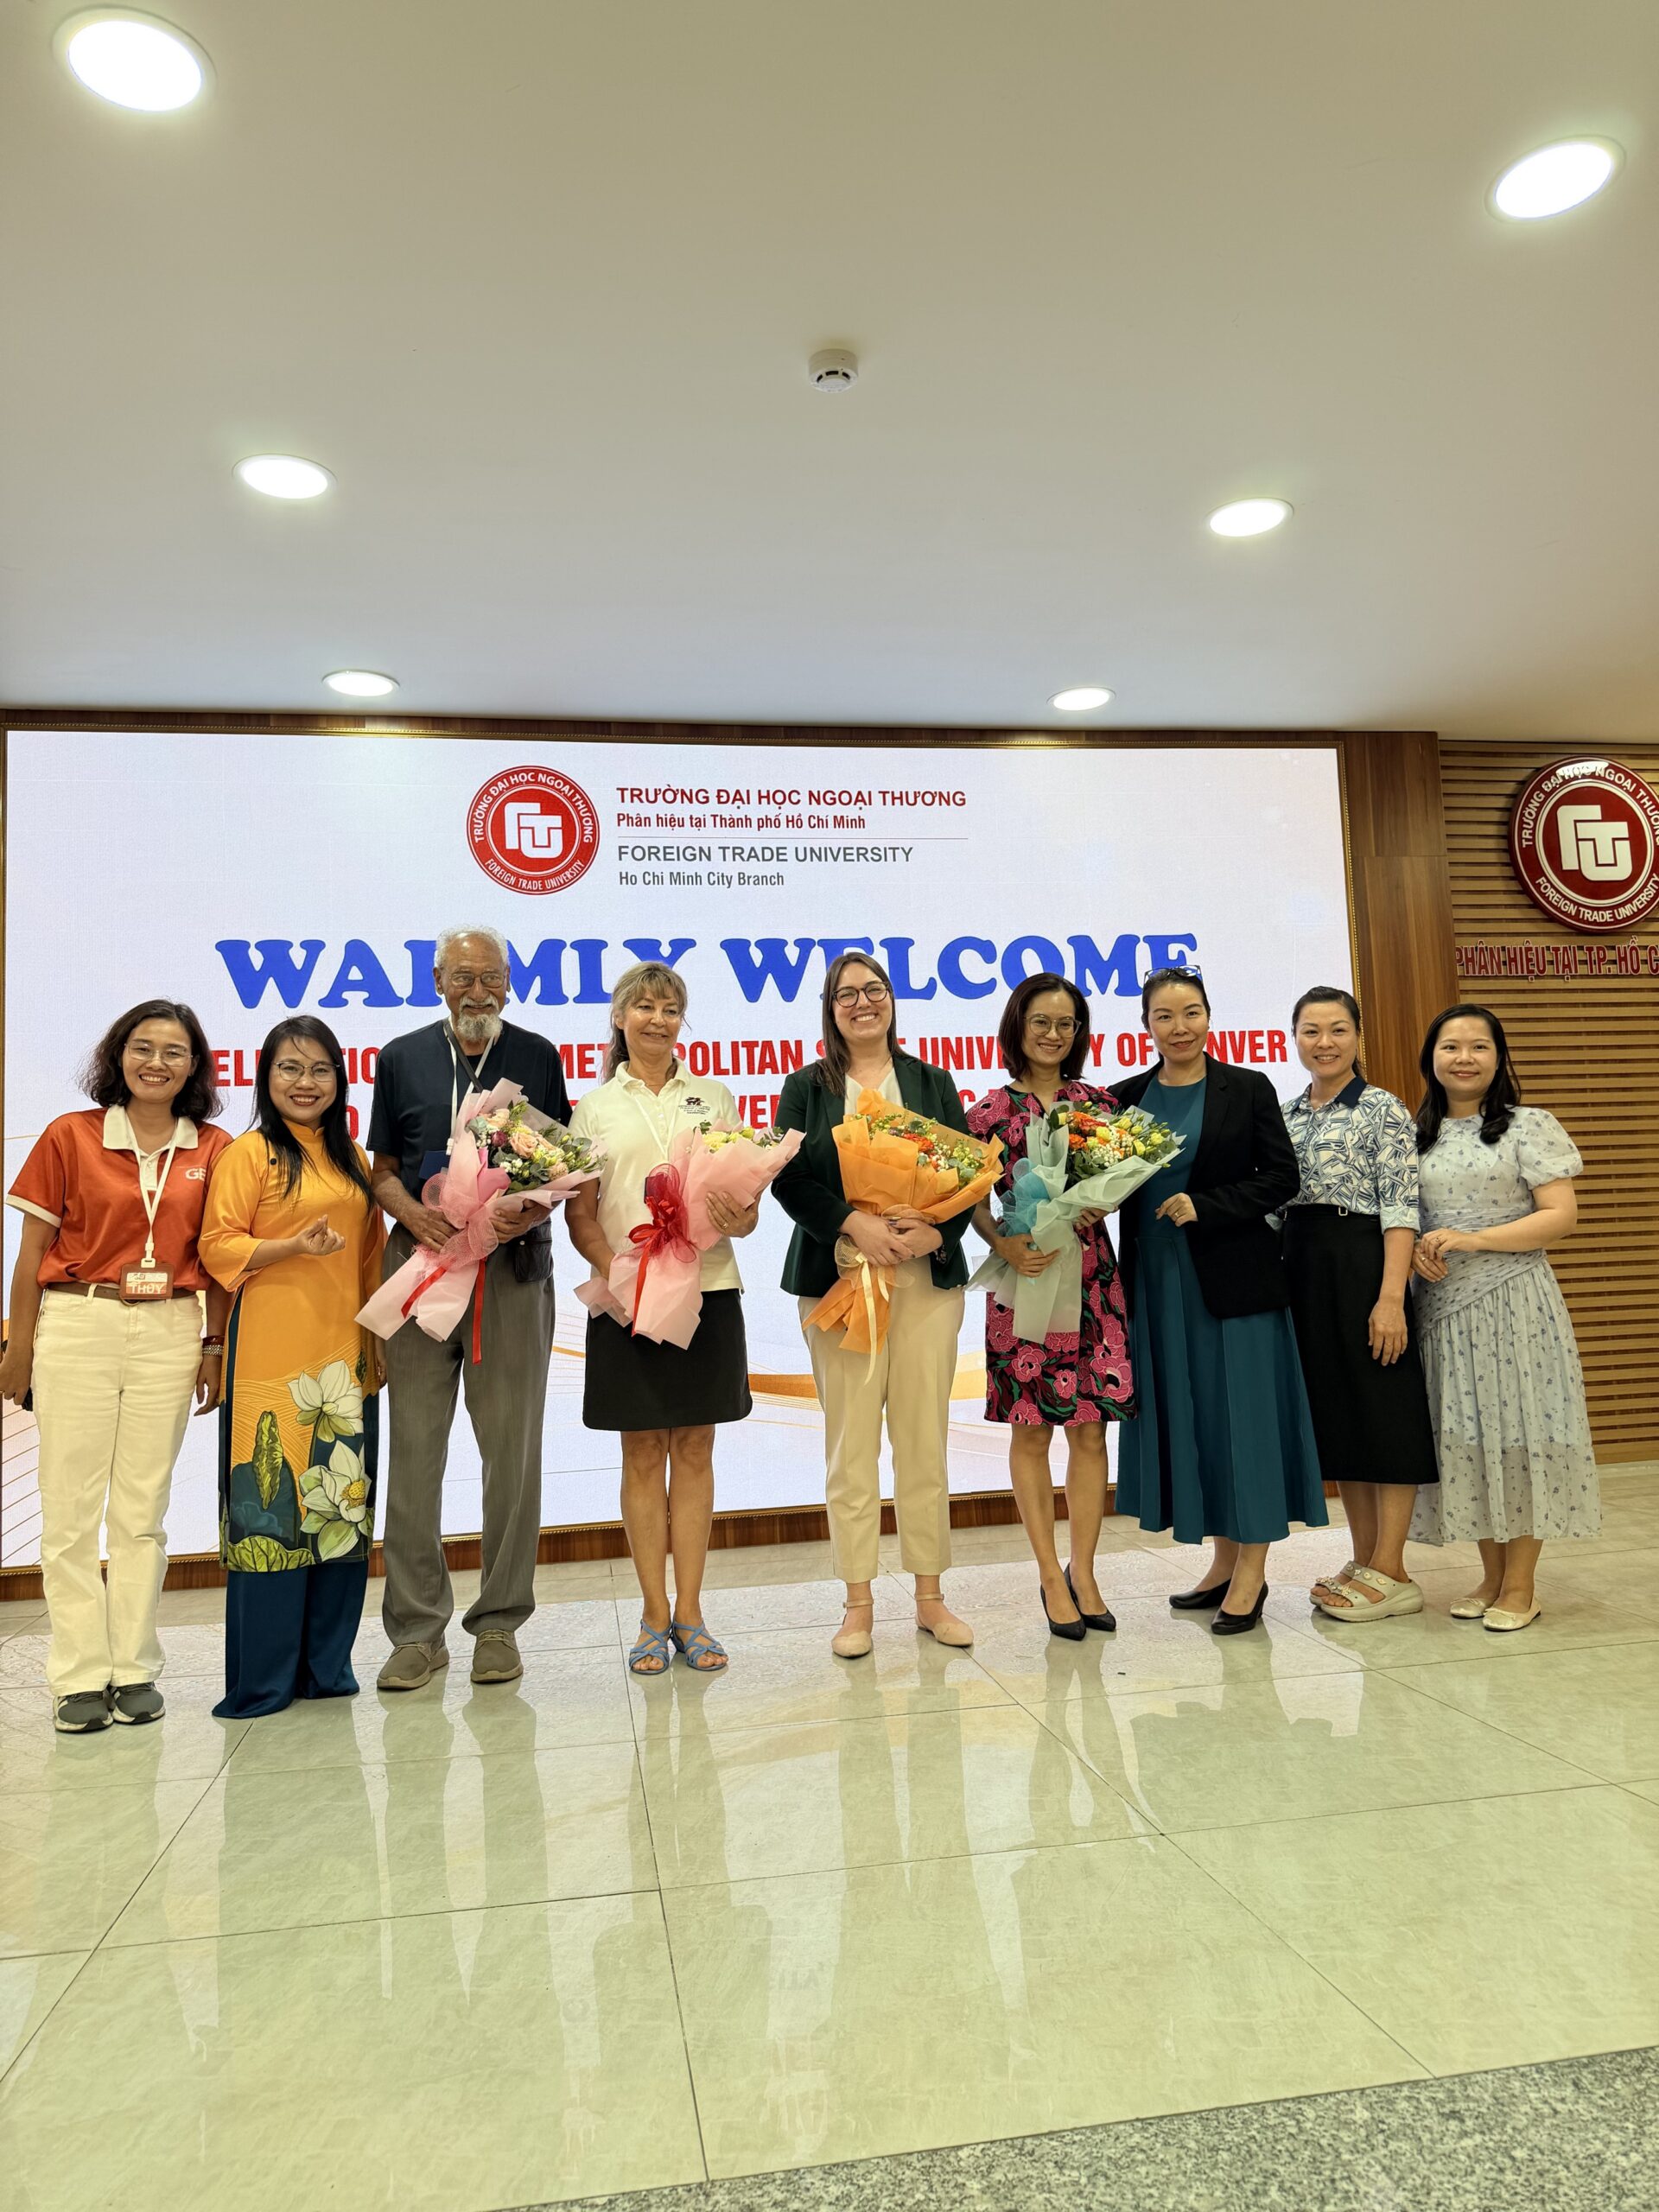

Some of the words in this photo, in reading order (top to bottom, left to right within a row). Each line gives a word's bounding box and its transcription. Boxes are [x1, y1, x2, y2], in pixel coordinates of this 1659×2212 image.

[510, 772, 535, 785] HỌC
[537, 772, 575, 796] NGOẠI
[616, 784, 710, 804] TRƯỜNG
[715, 788, 750, 810] ĐẠI
[758, 789, 801, 810] HỌC
[808, 790, 872, 810] NGOẠI
[878, 790, 966, 807] THƯƠNG
[616, 813, 652, 827] Phân
[656, 813, 685, 830] hiệu
[690, 814, 707, 831] tại
[710, 814, 752, 829] Thành
[757, 812, 782, 831] phố
[785, 812, 804, 829] Hồ
[808, 814, 829, 830] Chí
[833, 815, 866, 830] Minh
[618, 845, 712, 861] FOREIGN
[718, 846, 788, 862] TRADE
[795, 847, 913, 862] UNIVERSITY
[485, 858, 516, 885] FOREIGN
[518, 878, 543, 891] TRADE
[544, 859, 585, 889] UNIVERSITY
[619, 871, 638, 886] Ho
[642, 871, 664, 886] Chi
[670, 871, 702, 886] Minh
[707, 872, 733, 889] City
[738, 872, 785, 886] Branch
[1535, 876, 1578, 916] FOREIGN
[1579, 907, 1614, 923] TRADE
[1505, 939, 1548, 982] HIỆU
[1550, 944, 1580, 982] TẠI
[1584, 944, 1612, 976] TP.
[1616, 935, 1641, 976] HỒ
[1116, 1033, 1154, 1067] OF
